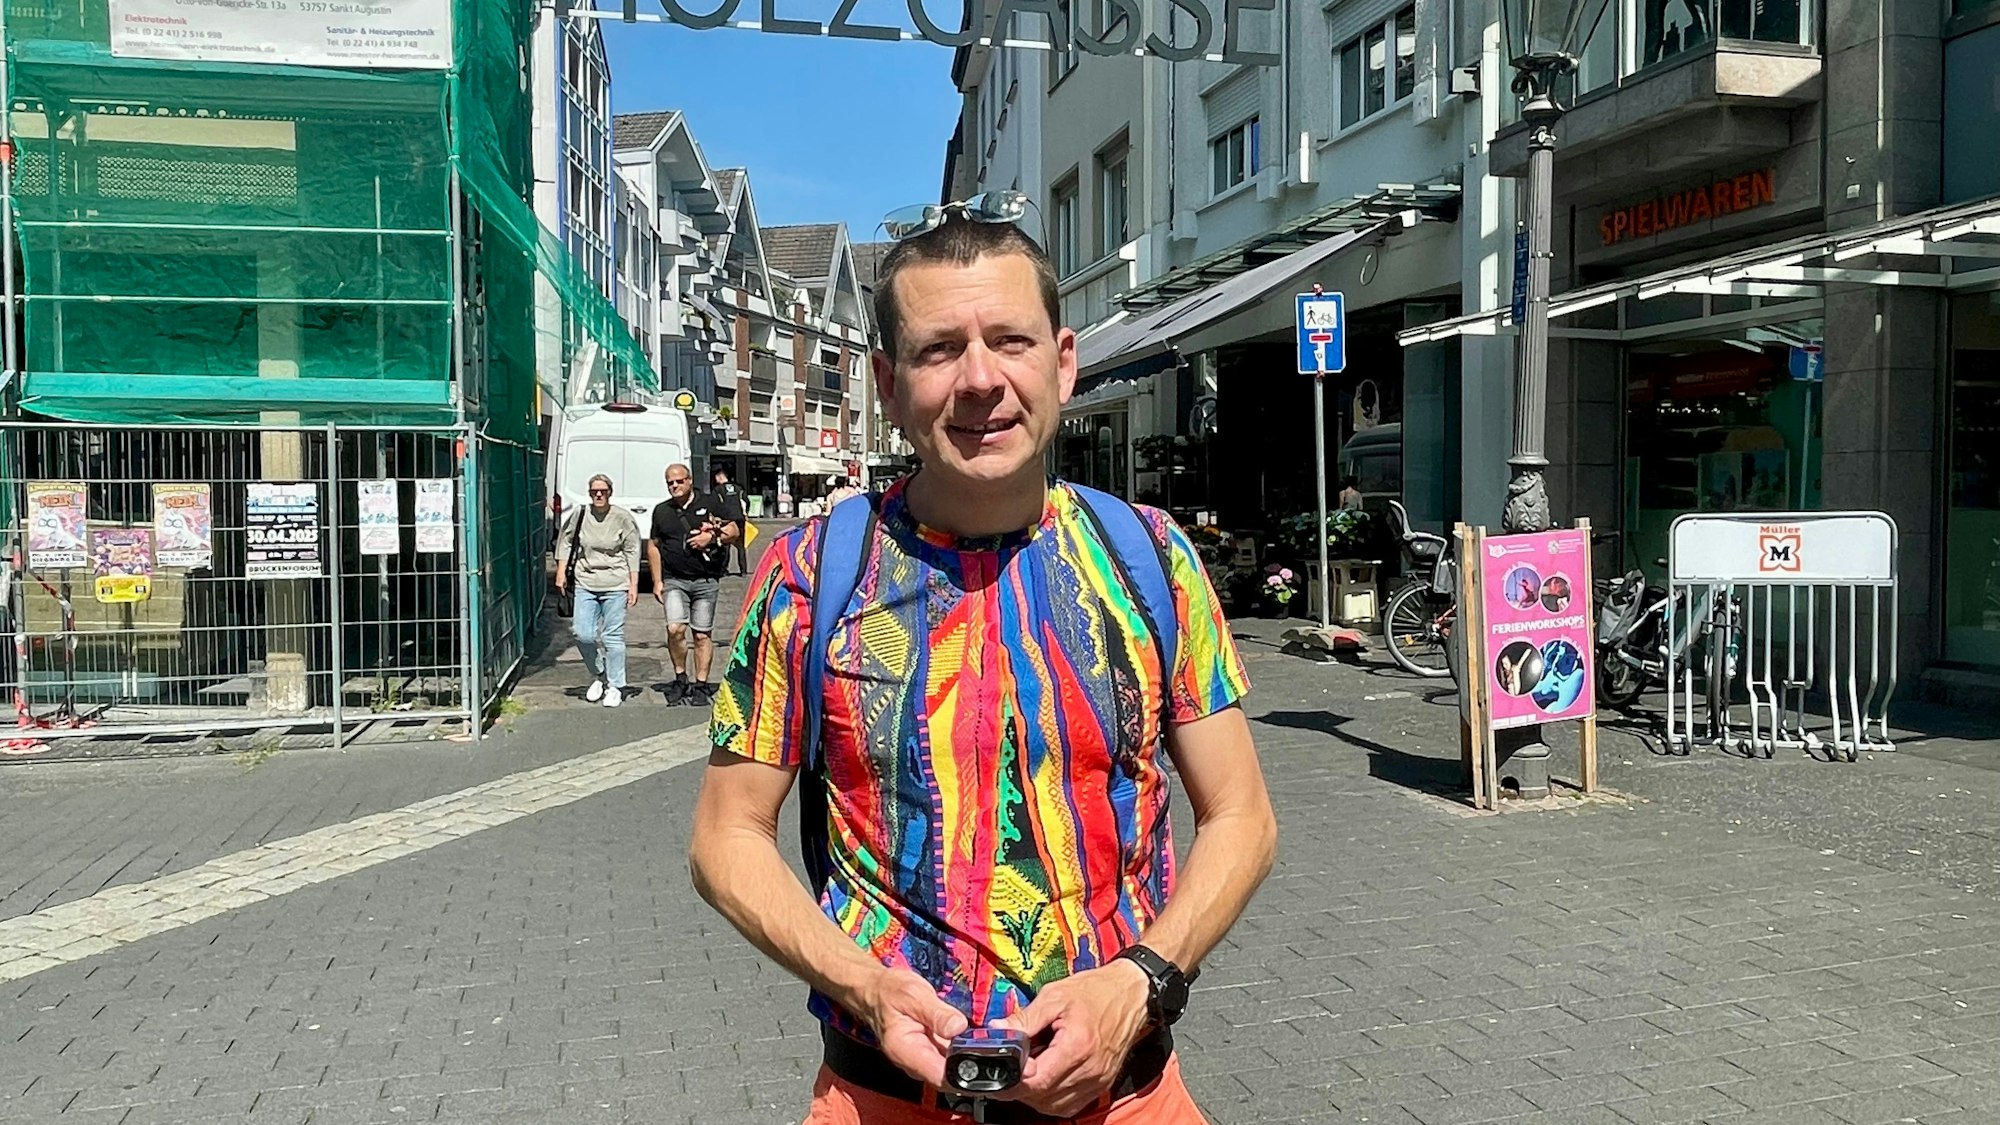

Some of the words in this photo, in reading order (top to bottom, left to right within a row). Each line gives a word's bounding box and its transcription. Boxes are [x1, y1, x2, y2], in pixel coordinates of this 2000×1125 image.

[300, 2, 327, 12] 53757
[329, 3, 353, 13] Sankt
[124, 14, 187, 25] Elektrotechnik
[369, 28, 435, 37] Heizungstechnik
[1599, 167, 1776, 247] SPIELWAREN
[247, 528, 319, 543] 30.04.2025
[1769, 545, 1791, 561] M
[1492, 615, 1585, 635] FERIENWORKSHOPS
